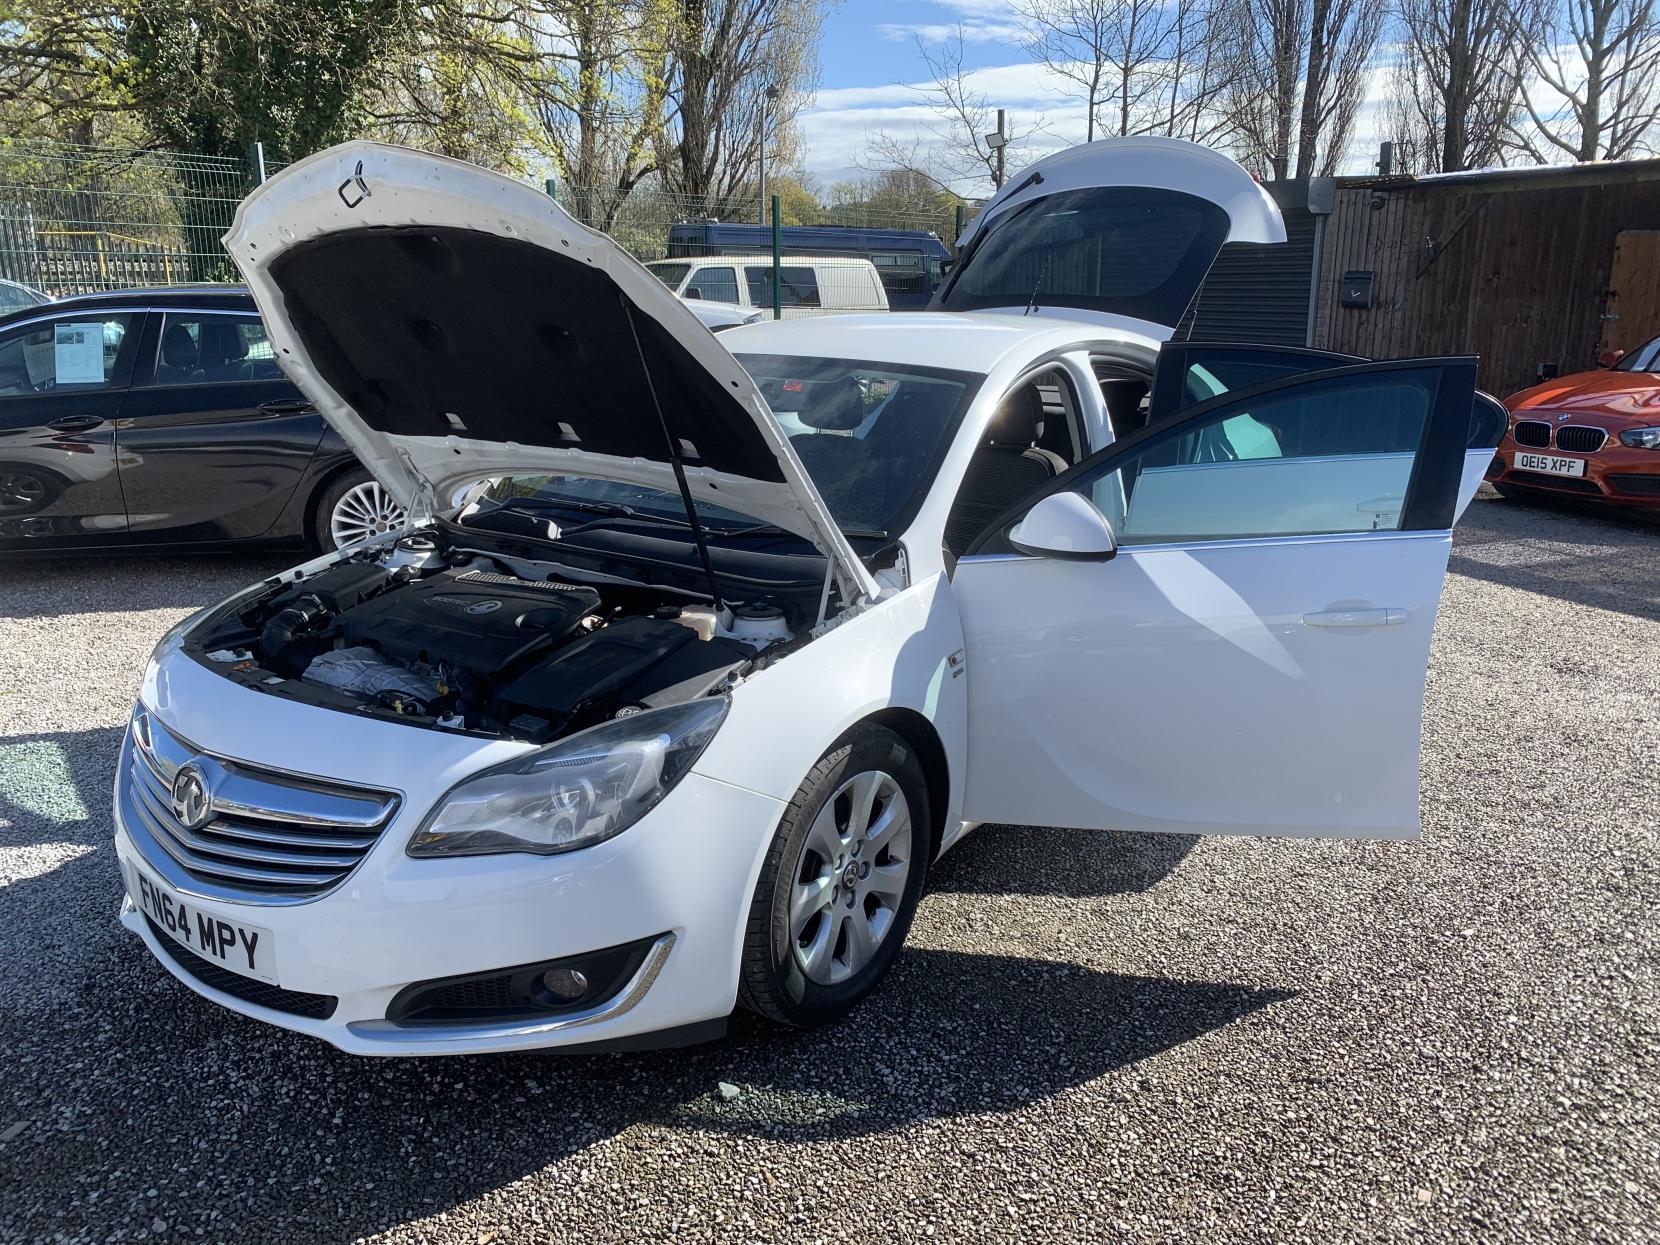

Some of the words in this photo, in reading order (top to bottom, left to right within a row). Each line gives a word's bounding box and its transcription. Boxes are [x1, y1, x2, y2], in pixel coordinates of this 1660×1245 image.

[1521, 455, 1548, 470] OE15
[1550, 458, 1577, 473] XPF
[138, 872, 192, 943] FN64
[196, 911, 259, 970] MPY
